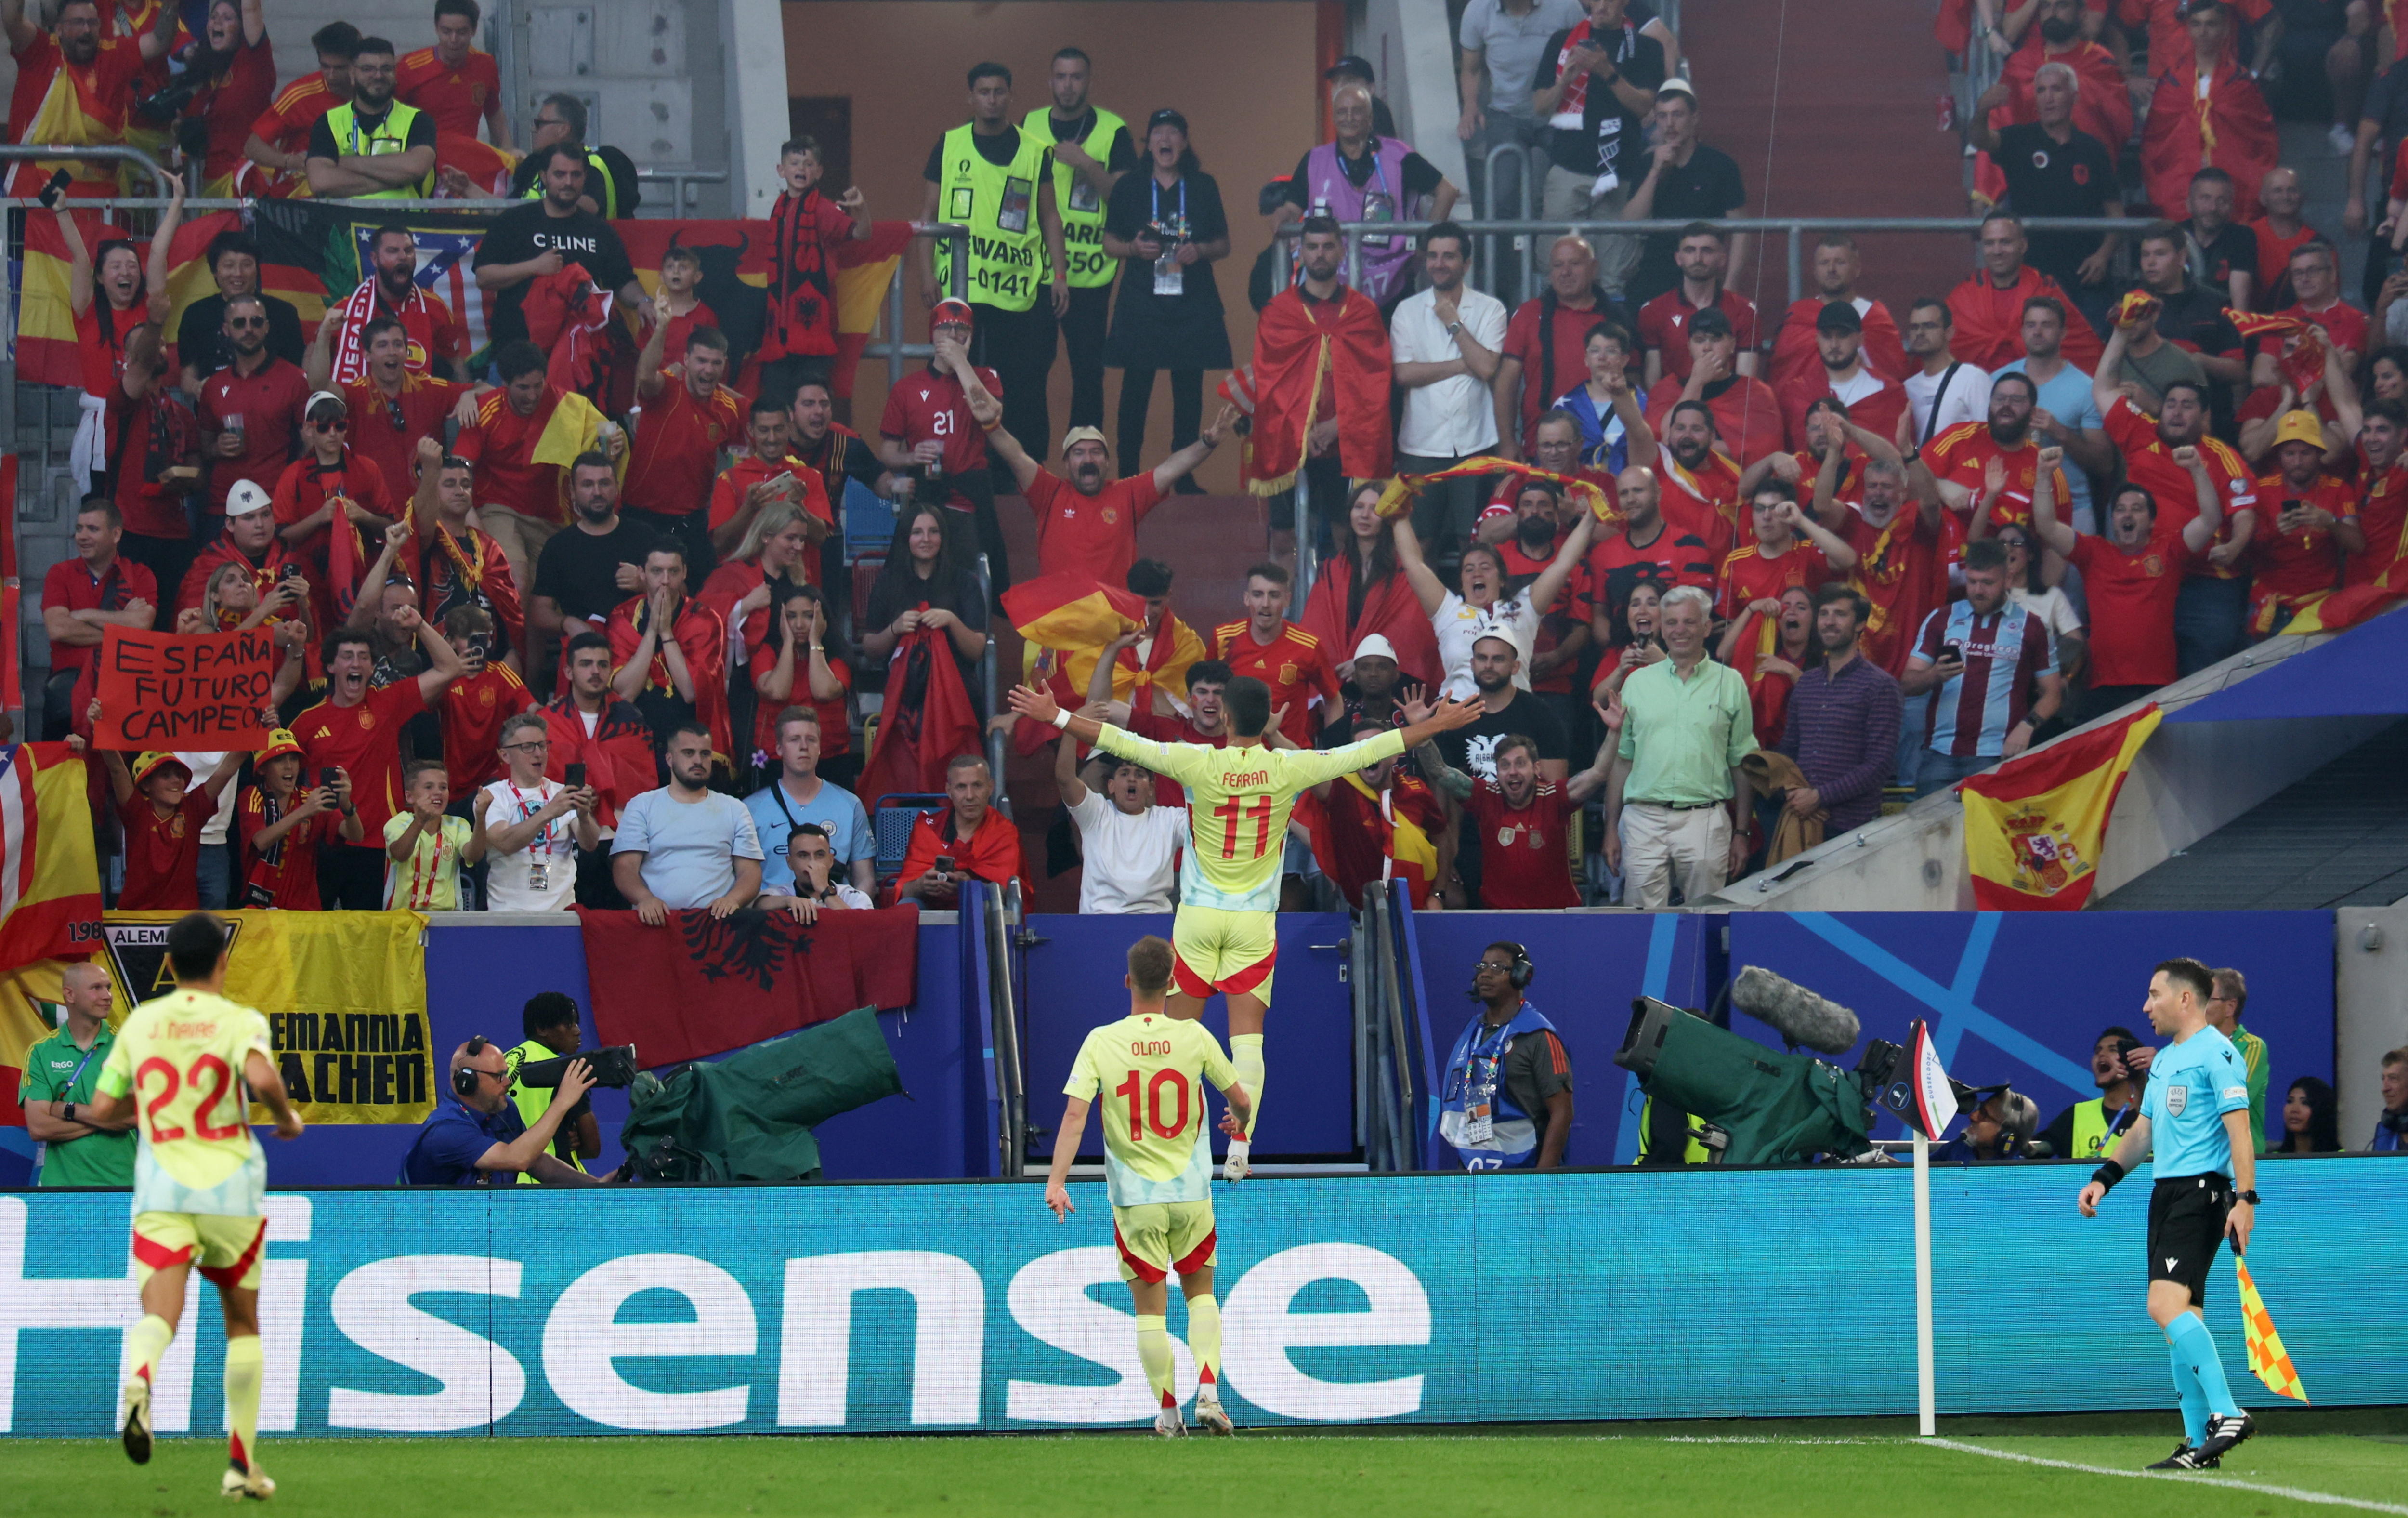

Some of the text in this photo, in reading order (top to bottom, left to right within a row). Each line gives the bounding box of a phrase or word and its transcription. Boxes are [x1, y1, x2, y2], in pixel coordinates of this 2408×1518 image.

[936, 235, 1033, 267] SWARD
[939, 265, 1029, 297] 0-0141
[934, 409, 954, 436] 21
[116, 632, 271, 674] ESPAÑA
[135, 671, 271, 707] FUTURO
[1222, 770, 1269, 788] FERRAN
[1213, 795, 1272, 860] 11
[1132, 1040, 1171, 1056] OLMO
[136, 1053, 239, 1143] 22
[1116, 1068, 1189, 1142] 10
[0, 1197, 1433, 1434] Hisense
